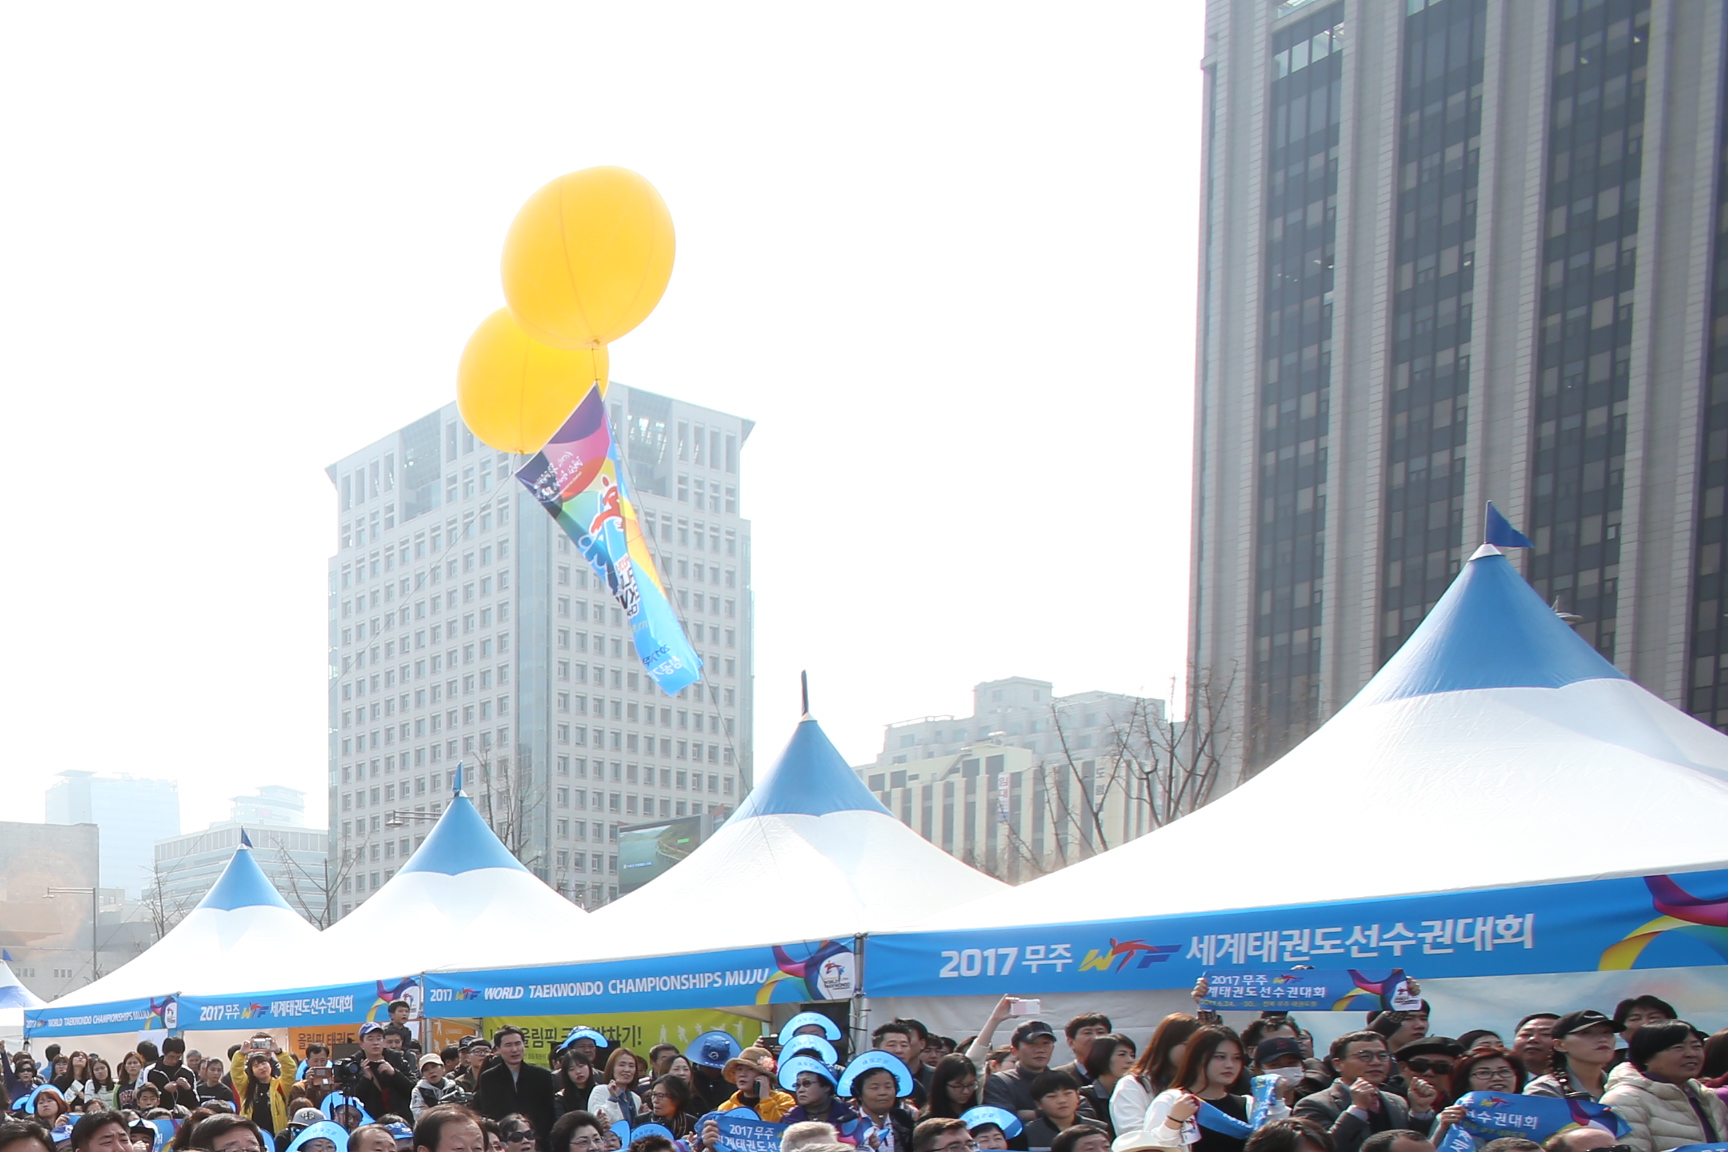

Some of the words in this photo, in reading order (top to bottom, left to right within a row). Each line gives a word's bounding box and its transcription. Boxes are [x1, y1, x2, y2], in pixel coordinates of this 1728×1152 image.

[938, 945, 1019, 978] 2017
[1021, 941, 1073, 975] 무주
[1185, 911, 1535, 964] 세계태권도선수권대회
[430, 989, 453, 1002] 2017
[484, 986, 525, 1000] WORLD
[529, 981, 604, 999] TAEKWONDO
[607, 971, 723, 995] CHAMPIONSHIPS
[724, 967, 770, 987] MUJU
[1211, 975, 1240, 985] 2017
[1243, 974, 1268, 986] 무주
[1207, 986, 1326, 999] 계태권도선수권대회
[200, 1005, 224, 1021] 2017
[225, 1003, 240, 1020] 무주
[270, 995, 353, 1018] 세계태권도선수권대회
[48, 1018, 63, 1027] WORLD
[64, 1015, 92, 1027] TAEKWONDO
[93, 1012, 133, 1024] CHAMPIONSHIPS
[729, 1124, 753, 1136] 2017
[754, 1124, 774, 1137] 무주
